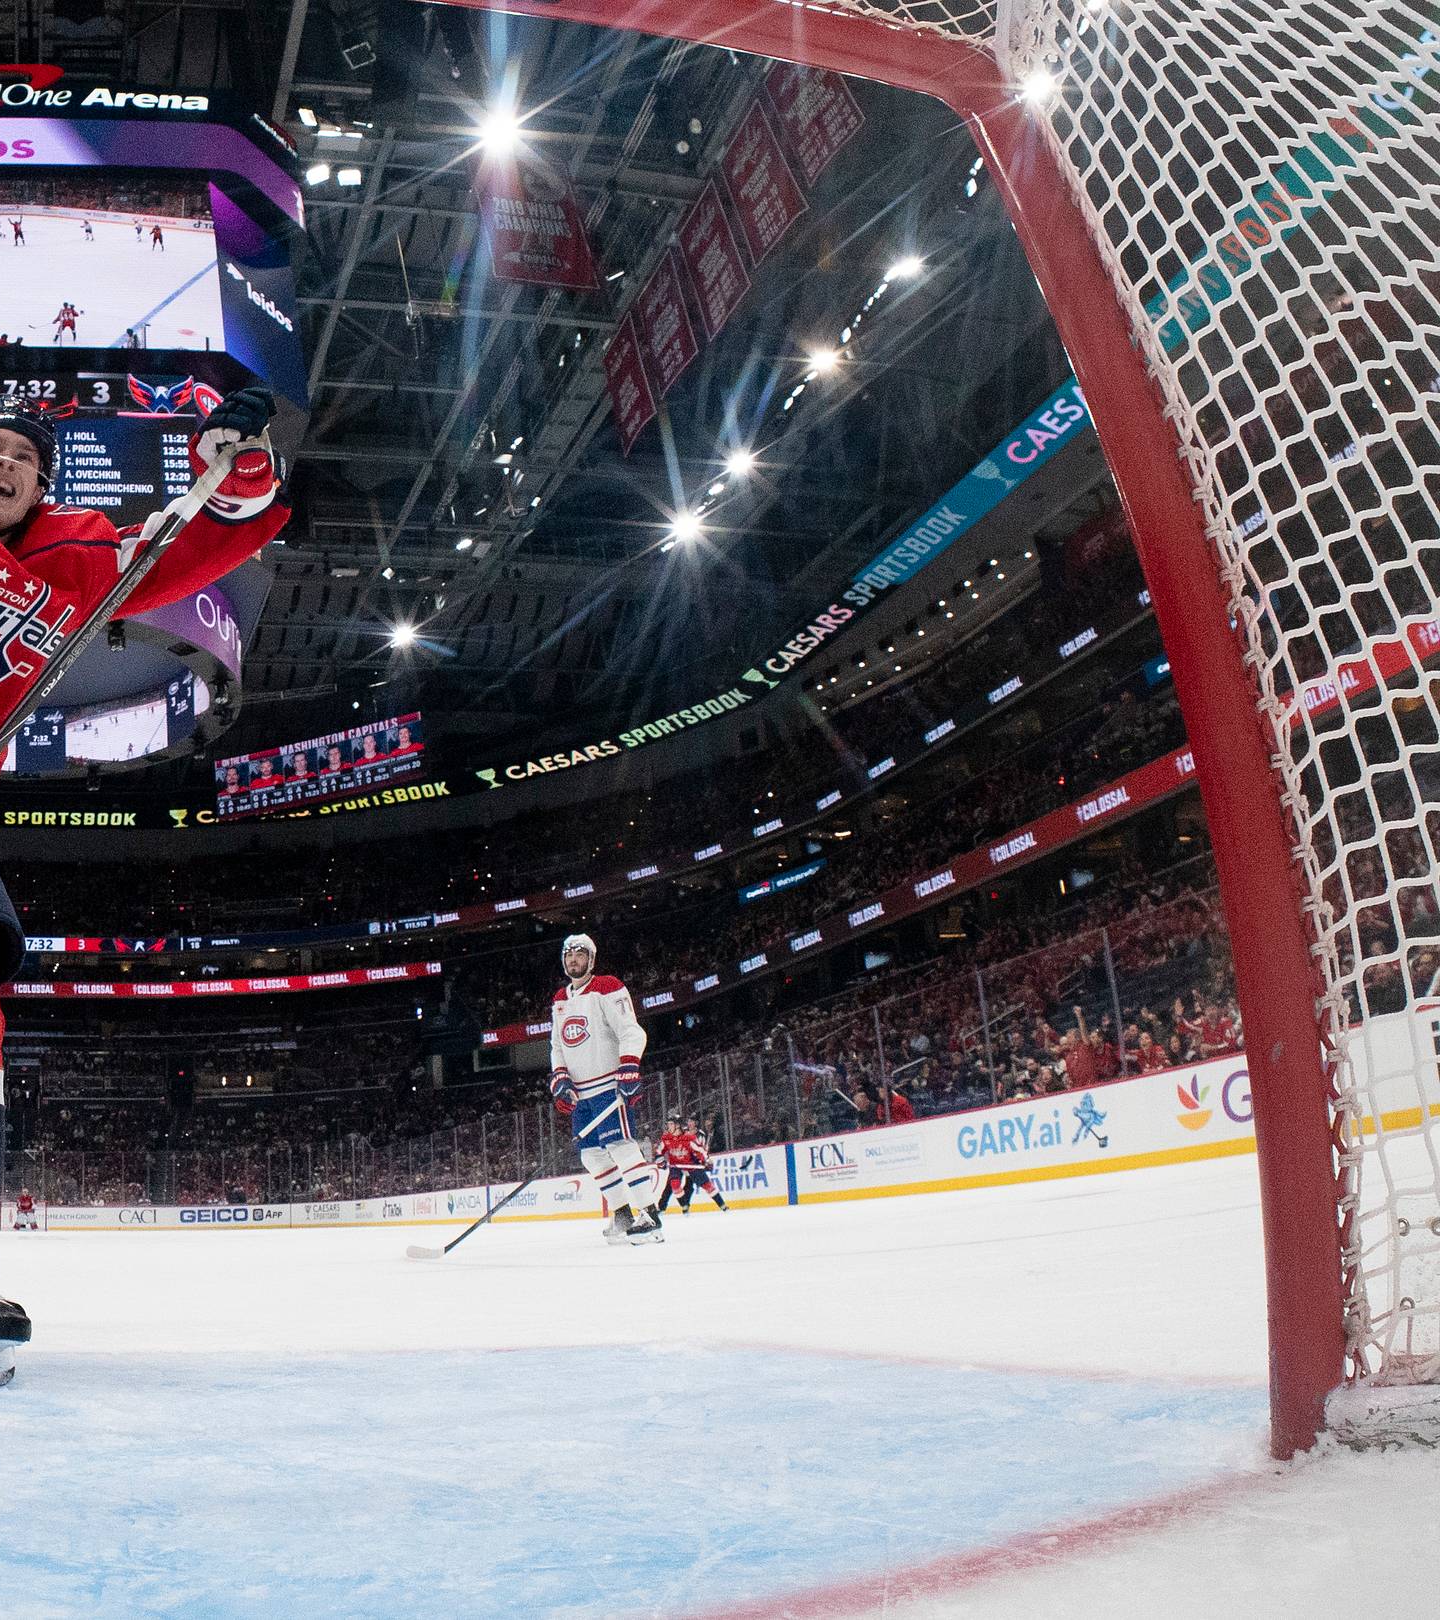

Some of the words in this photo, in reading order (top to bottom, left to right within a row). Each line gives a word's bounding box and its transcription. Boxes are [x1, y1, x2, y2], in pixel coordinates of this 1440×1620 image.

[81, 88, 209, 111] Arena
[246, 281, 293, 332] leidos
[3, 380, 56, 399] 7:32
[92, 382, 110, 404] 3
[65, 432, 72, 441] J.
[74, 432, 97, 441] HOLL
[162, 434, 188, 443] 11:22
[65, 444, 70, 454] I.
[72, 444, 106, 454] PROTAS
[163, 447, 189, 456] 12:20
[65, 457, 73, 466] C.
[75, 457, 112, 466] HUTSON
[164, 459, 189, 468] 15:55
[65, 470, 74, 479] A.
[75, 470, 121, 479] OVECHKIN
[164, 472, 190, 481] 12:20
[65, 483, 71, 493] I.
[72, 483, 154, 493] MIROSHNICHENKO
[168, 485, 189, 494] 9:58
[65, 496, 74, 506] C.
[75, 496, 122, 506] LINDGREN
[765, 603, 853, 675] CAESARS
[844, 507, 967, 607] SPORTSBOOK
[1064, 627, 1098, 656] COLOSSAL
[41, 670, 65, 698] PRO
[991, 676, 1023, 703] COLOSSAL
[279, 733, 345, 755] WASHINGTON
[348, 718, 398, 740] CAPITALS
[506, 740, 618, 780] CAESARS
[620, 688, 752, 750] SPORTSBOOK
[927, 719, 956, 744] COLOSSAL
[1083, 786, 1131, 822] COLOSSAL
[4, 812, 137, 826] SPORTSBOOK
[698, 844, 723, 860] COLOSSAL
[995, 832, 1038, 865] COLOSSAL
[631, 865, 659, 880] COLOSSAL
[567, 884, 594, 898] COLOSSAL
[918, 870, 956, 898] COLOSSAL
[498, 899, 527, 911] COLOSSAL
[852, 902, 885, 928] COLOSSAL
[27, 940, 53, 950] 7:32
[78, 940, 85, 950] 3
[794, 929, 822, 952] COLOSSAL
[312, 973, 348, 985] COLOSSAL
[371, 967, 408, 980] COLOSSAL
[18, 984, 55, 994] COLOSSAL
[78, 984, 115, 994] COLOSSAL
[137, 984, 174, 994] COLOSSAL
[196, 981, 233, 993] COLOSSAL
[254, 978, 290, 989] COLOSSAL
[646, 992, 674, 1008] COLOSSAL
[958, 1110, 1060, 1159] GARY.ai
[810, 1142, 847, 1169] FCN
[313, 1204, 340, 1212] CAESARS
[456, 1195, 481, 1208] VANDA
[119, 1209, 157, 1224] CACI
[180, 1208, 247, 1224] GEICO
